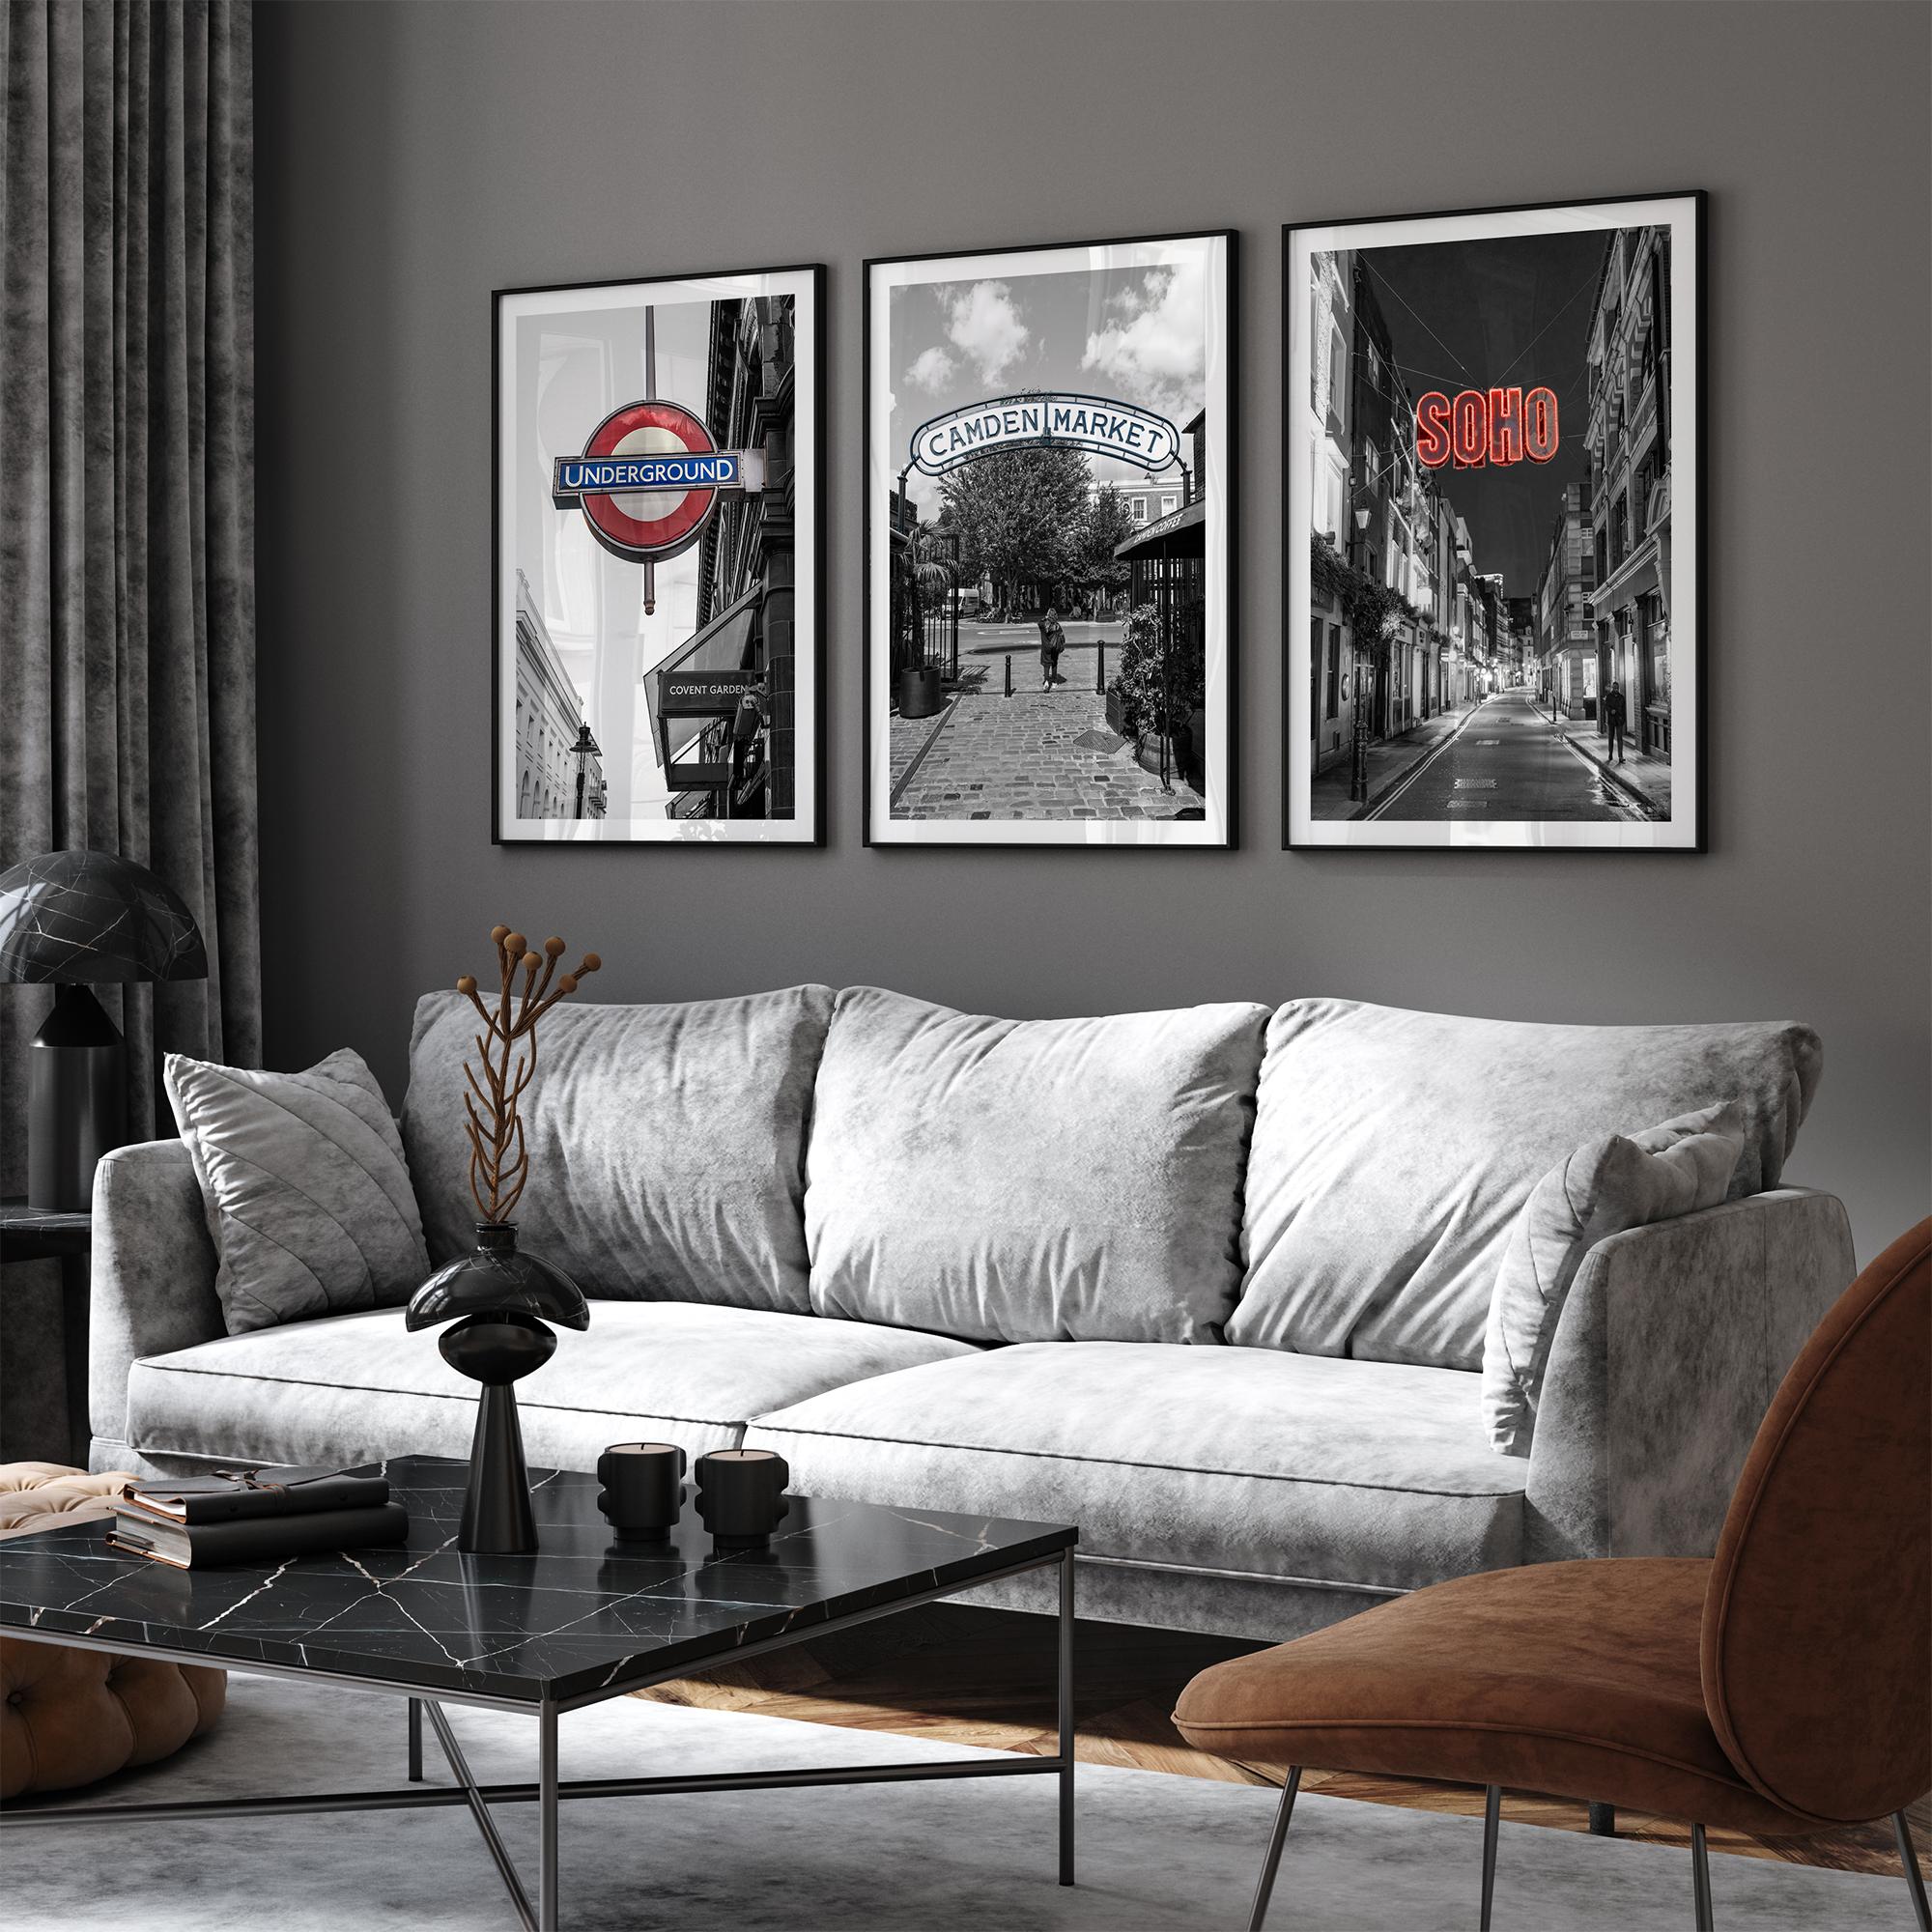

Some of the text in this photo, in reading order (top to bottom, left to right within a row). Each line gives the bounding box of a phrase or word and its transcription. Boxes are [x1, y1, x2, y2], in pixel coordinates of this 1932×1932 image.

[929, 409, 1163, 456] CAMDEN MARKET
[1416, 386, 1559, 467] SOHO
[565, 459, 733, 488] UNDERGROUND
[669, 685, 707, 695] COVENT
